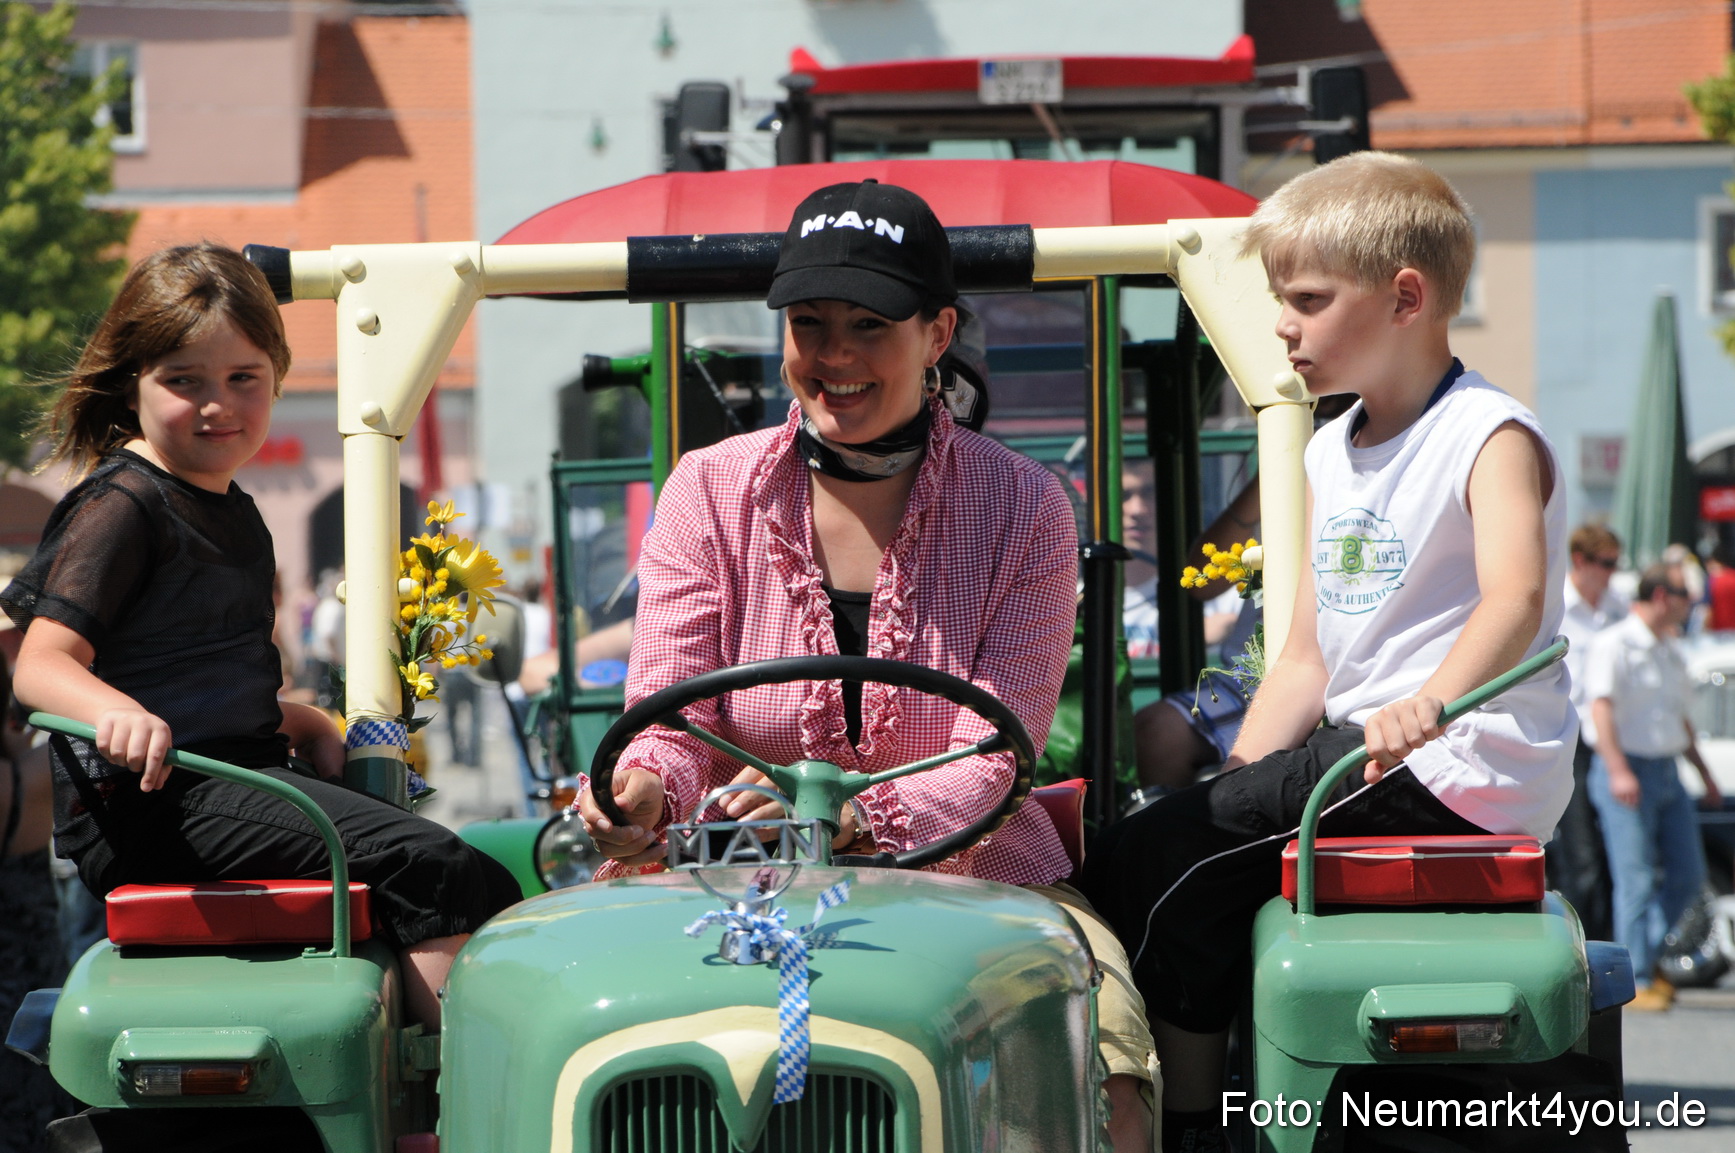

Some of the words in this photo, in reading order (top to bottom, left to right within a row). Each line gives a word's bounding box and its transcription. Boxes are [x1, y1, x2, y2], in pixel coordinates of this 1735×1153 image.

[1341, 534, 1364, 574] 8
[1376, 550, 1403, 564] 1977
[1320, 585, 1332, 601] 100
[666, 818, 822, 869] MAN
